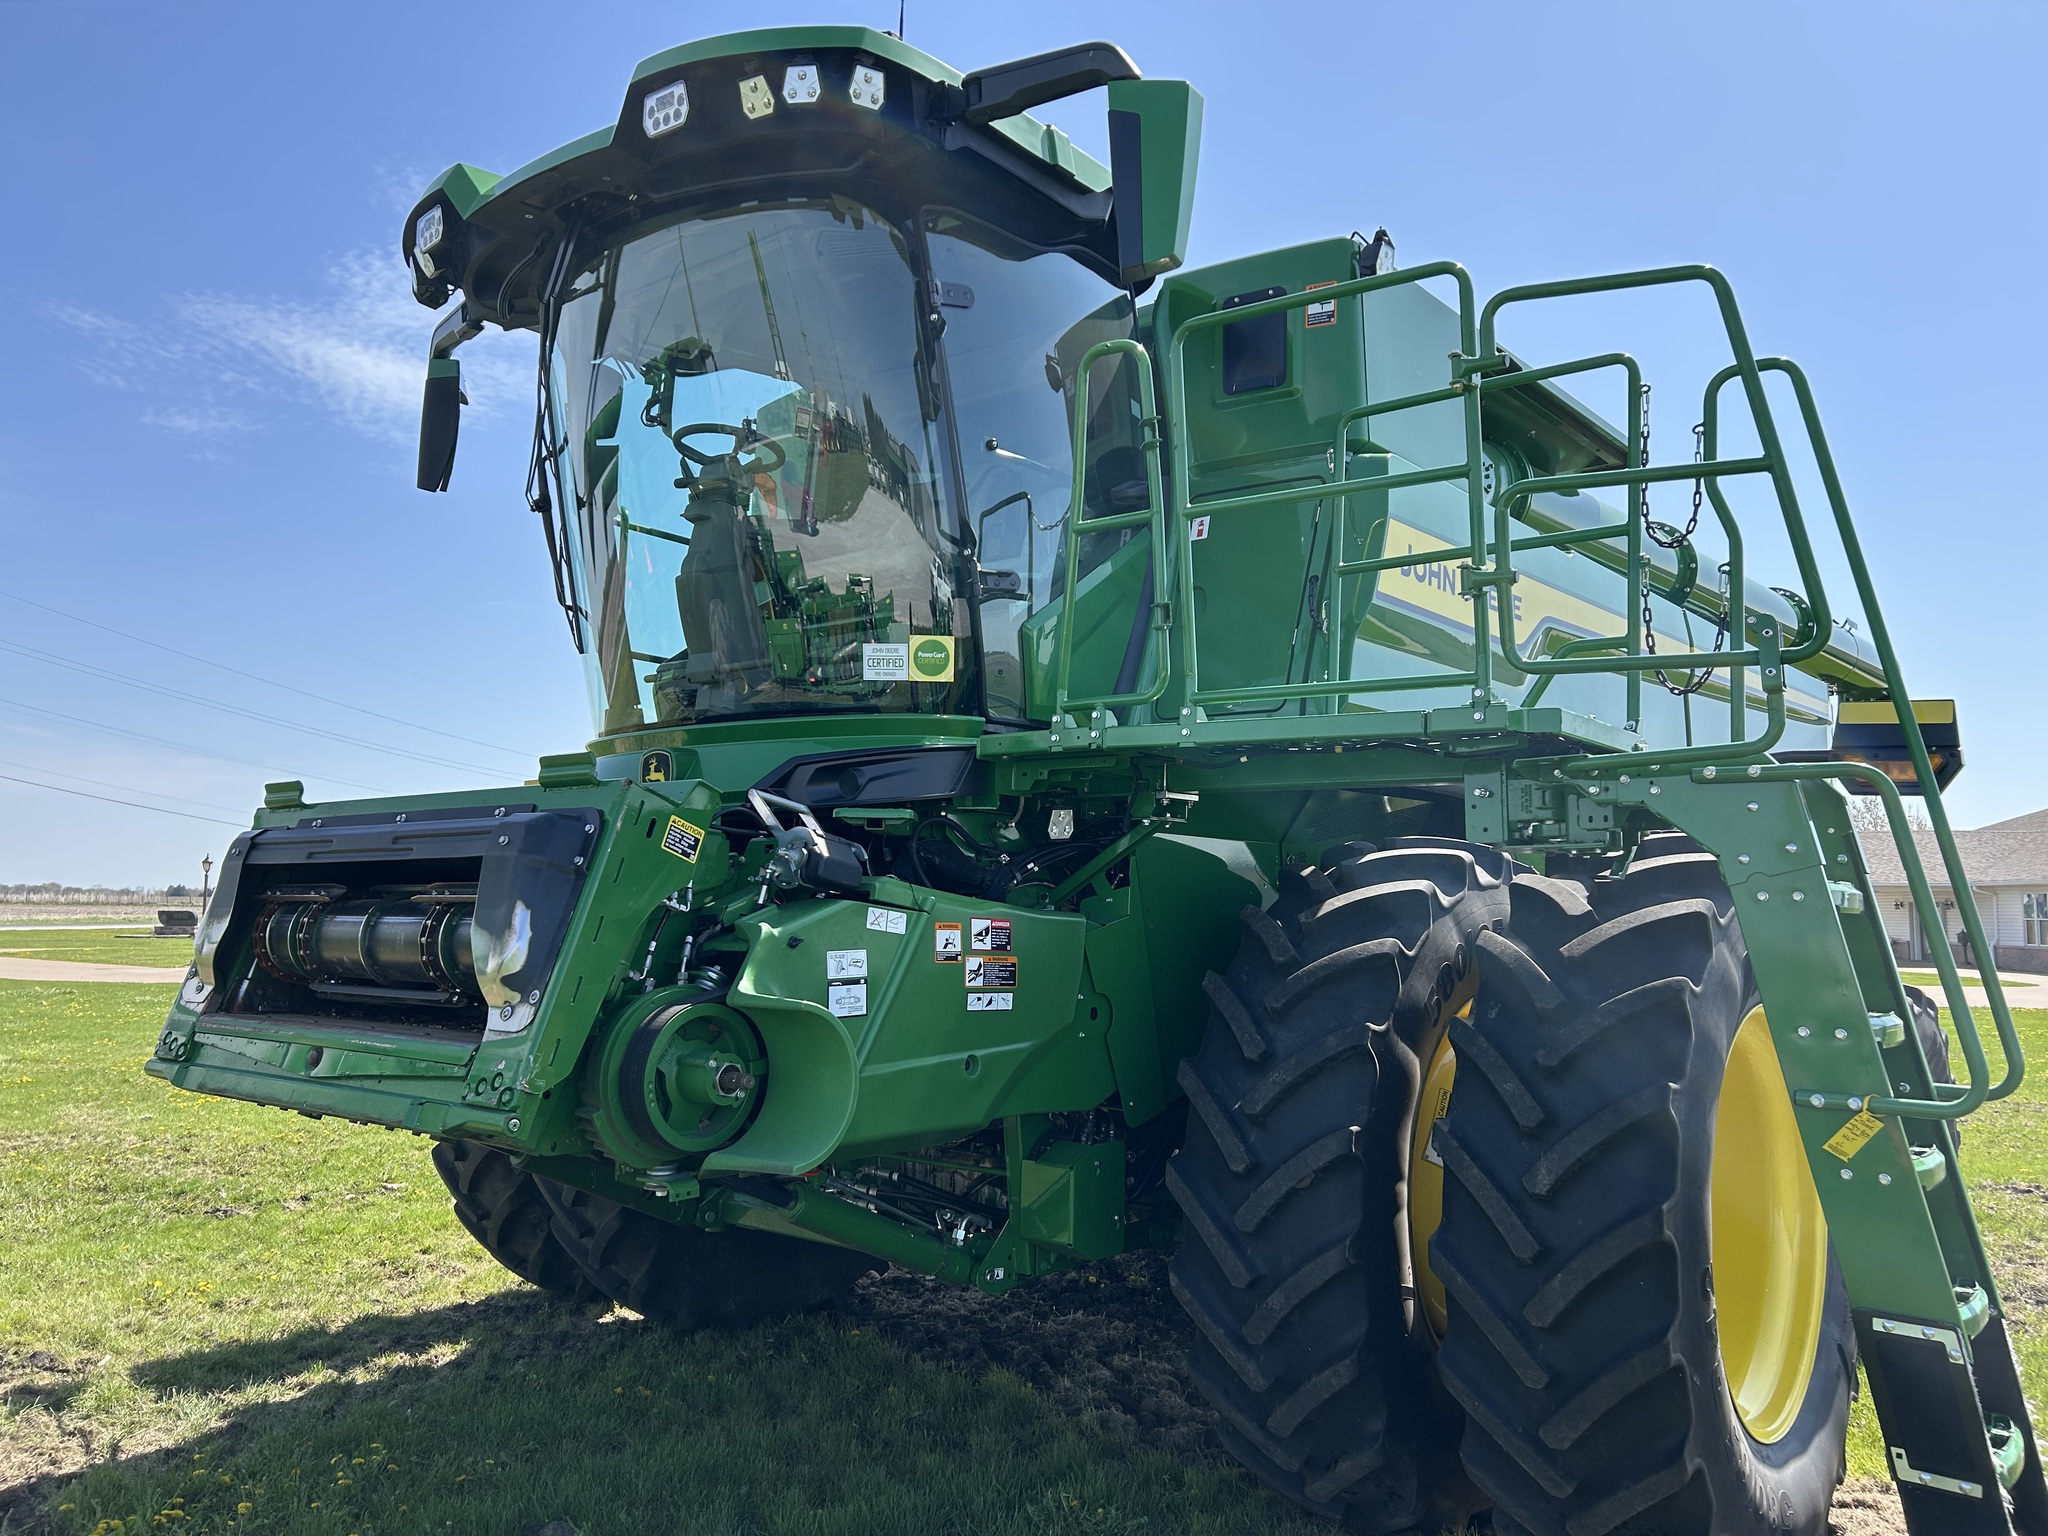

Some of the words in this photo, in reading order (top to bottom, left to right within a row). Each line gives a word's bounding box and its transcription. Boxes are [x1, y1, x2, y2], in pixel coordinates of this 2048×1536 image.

[1400, 544, 1456, 596] JOHN
[867, 657, 904, 668] CERTIFIED
[676, 820, 703, 838] CAUTION
[1437, 1090, 1449, 1117] CAUTION
